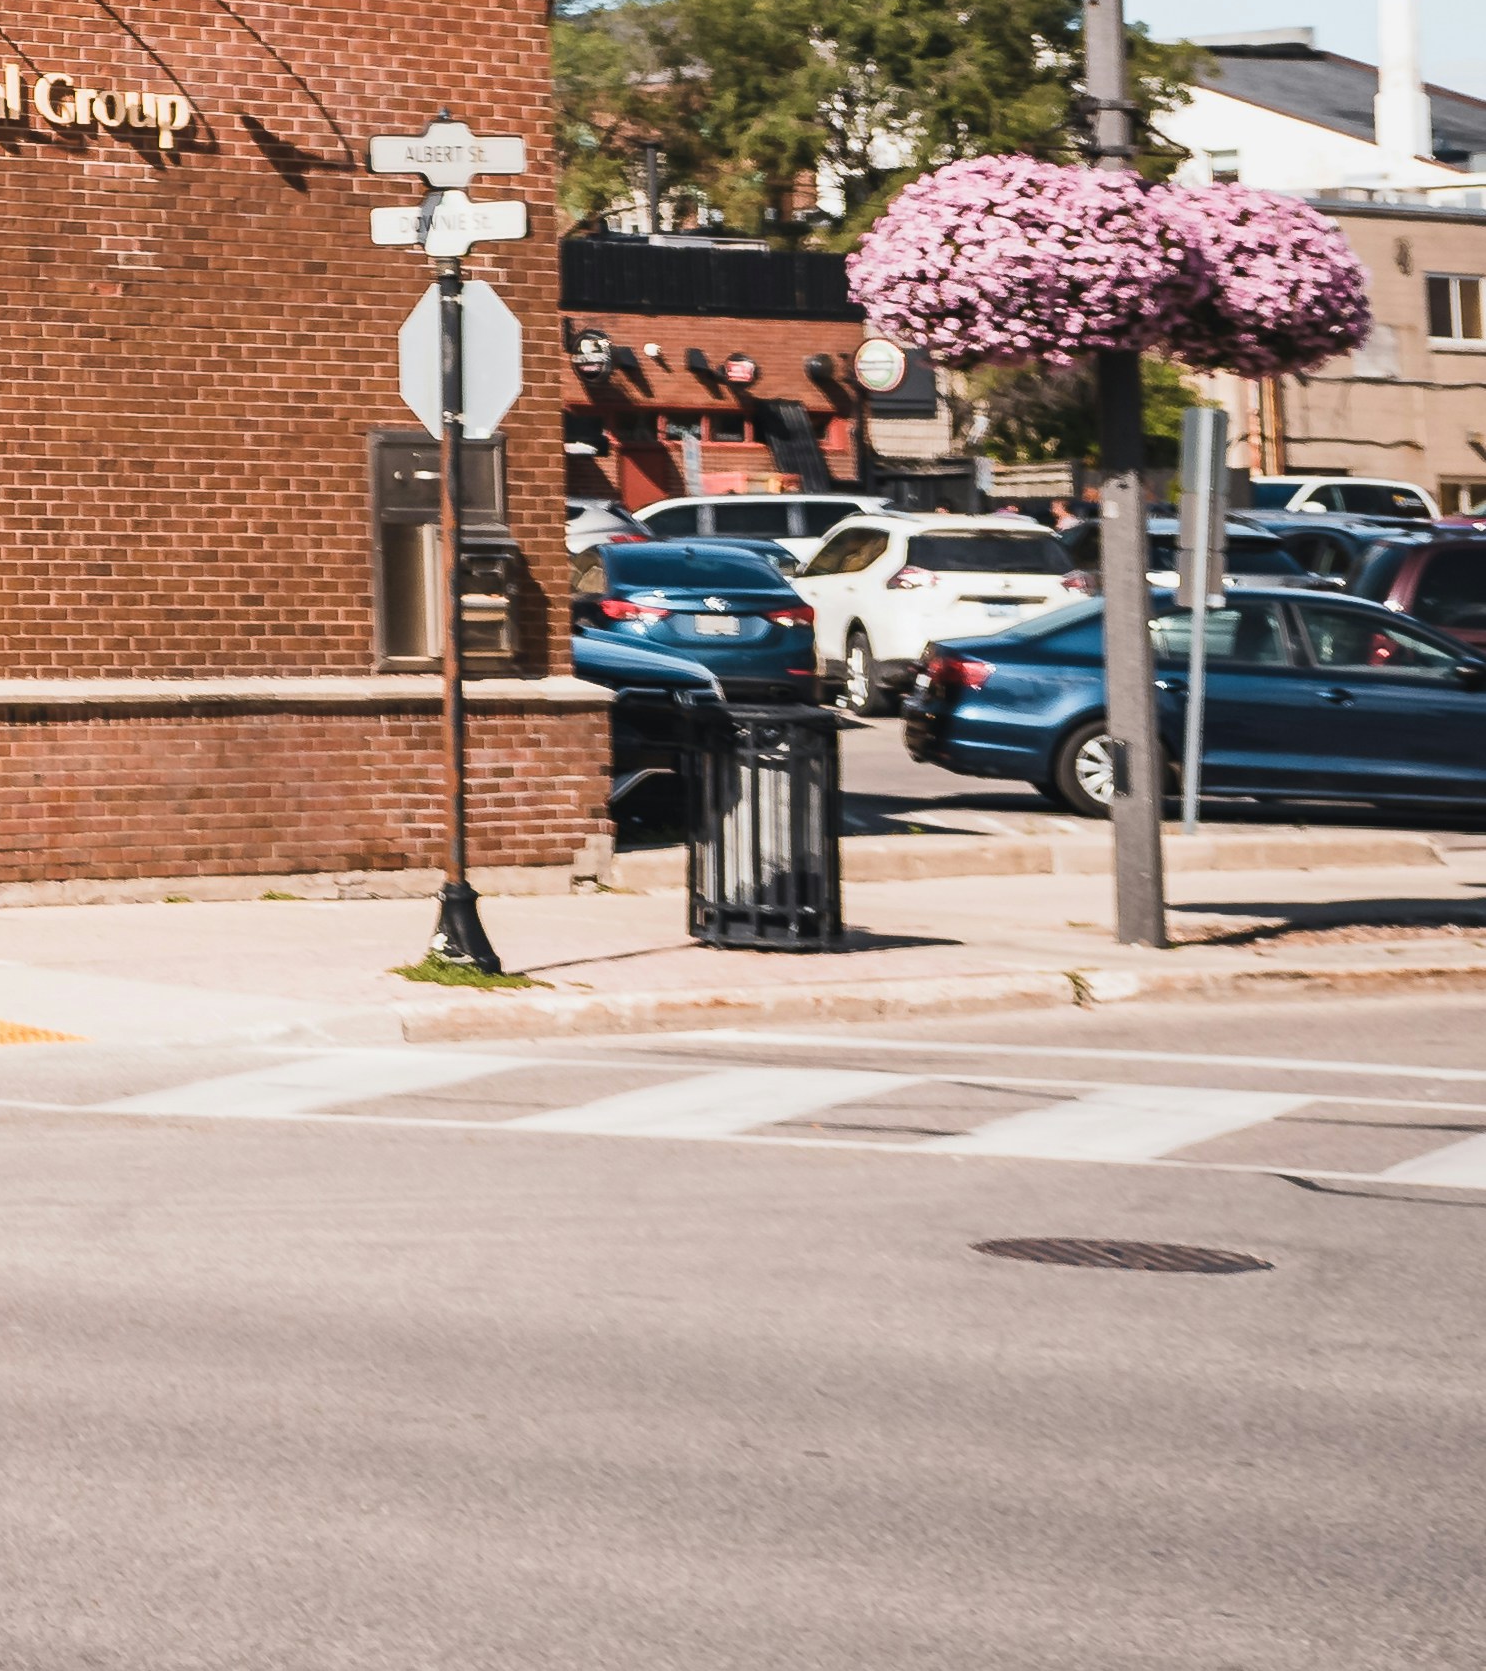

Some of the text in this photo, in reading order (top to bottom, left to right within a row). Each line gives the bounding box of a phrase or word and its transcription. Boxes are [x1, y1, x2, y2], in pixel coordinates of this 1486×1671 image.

[33, 72, 191, 149] Group
[405, 145, 463, 163] ALBERT
[399, 213, 466, 233] DOWNIE
